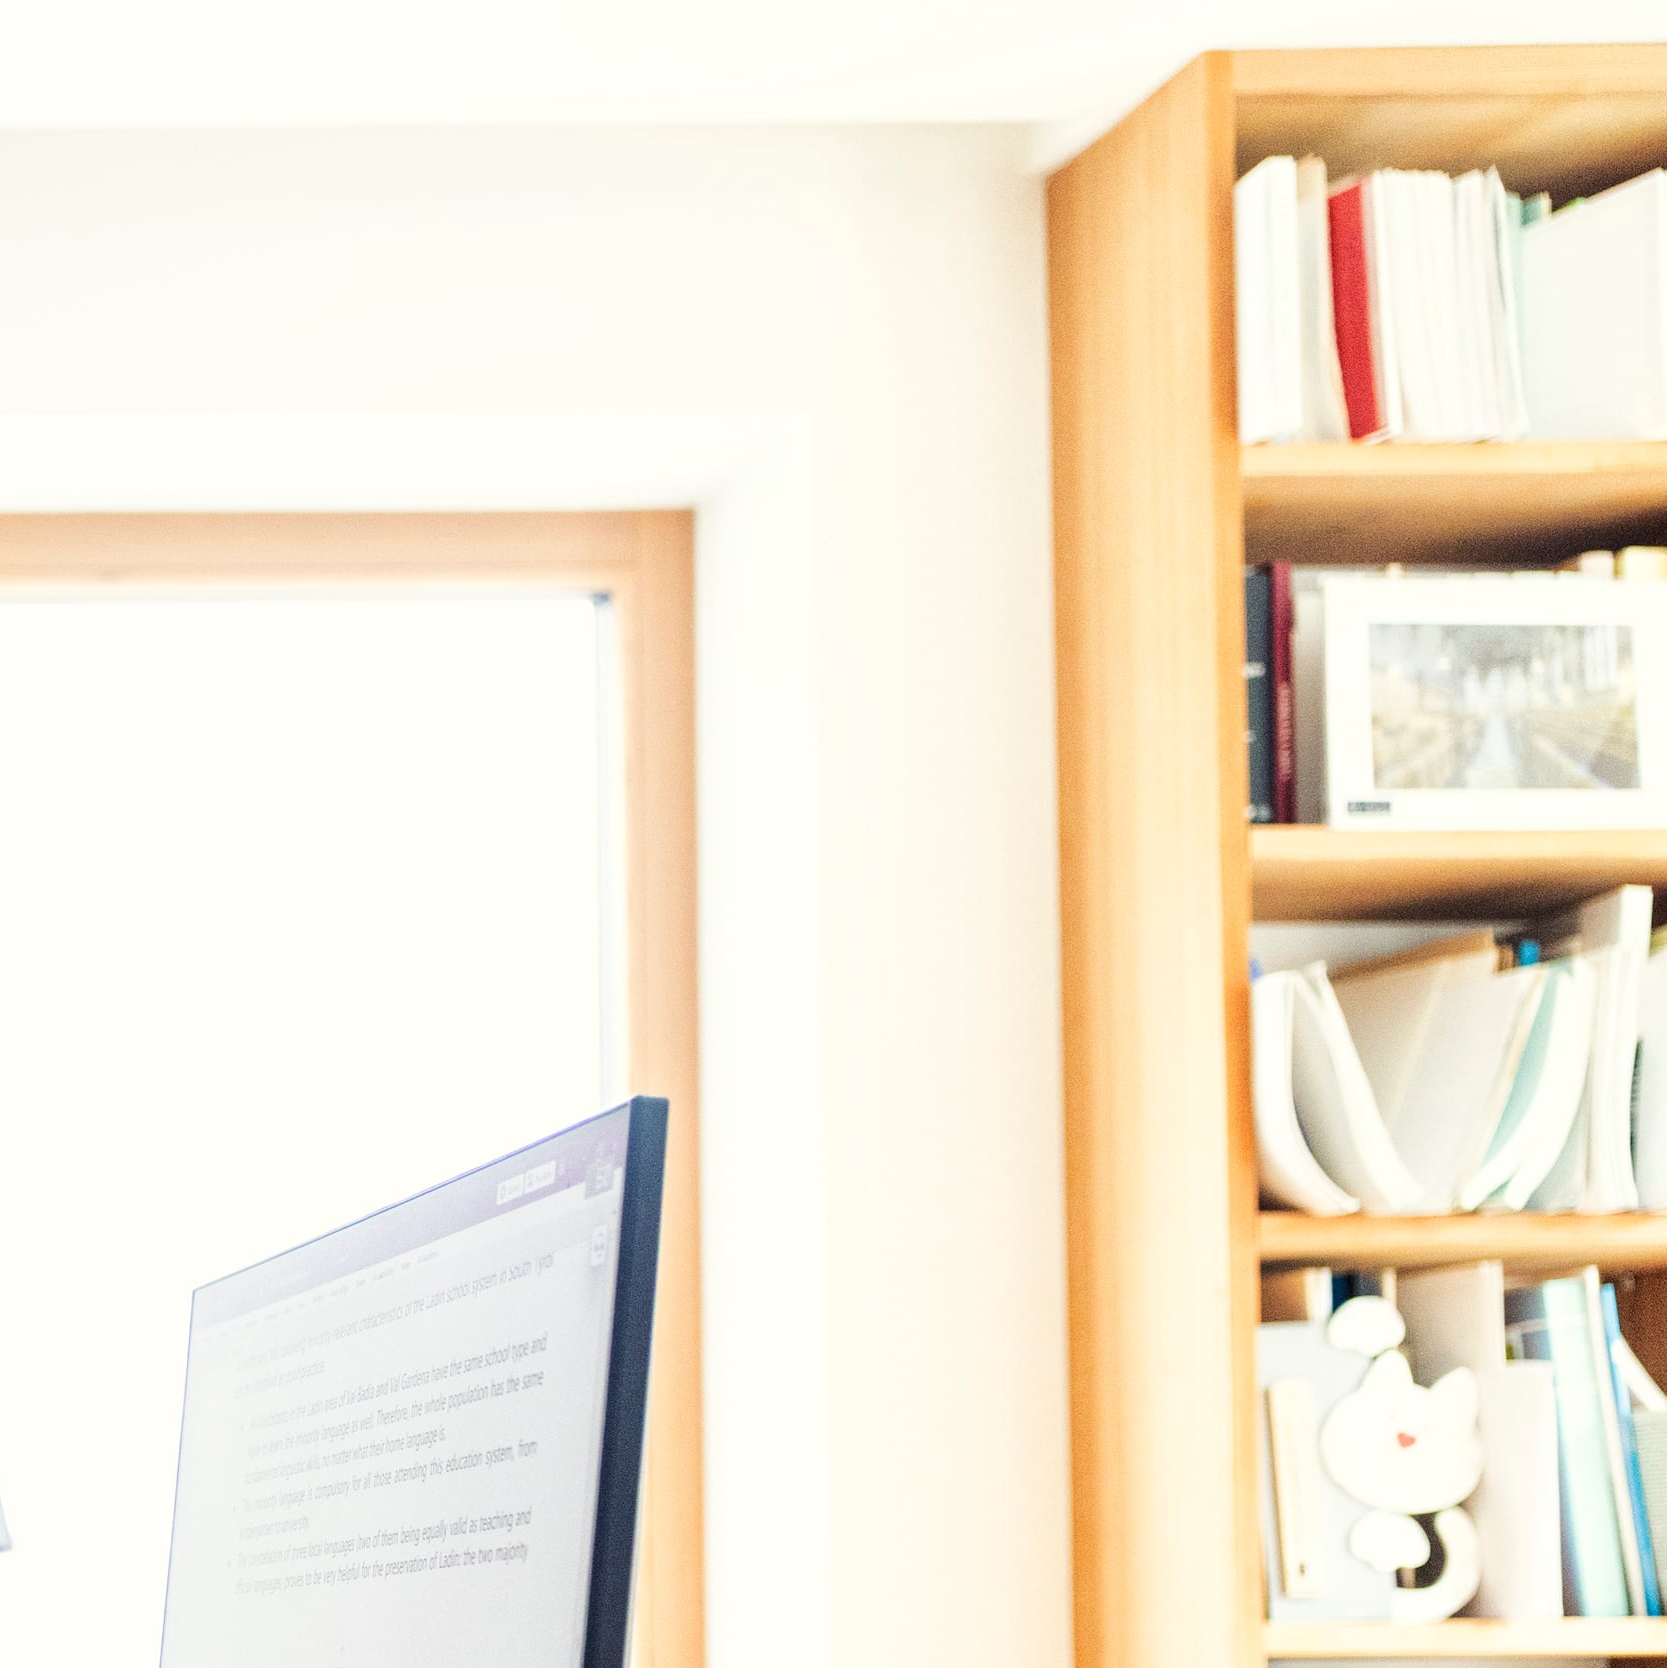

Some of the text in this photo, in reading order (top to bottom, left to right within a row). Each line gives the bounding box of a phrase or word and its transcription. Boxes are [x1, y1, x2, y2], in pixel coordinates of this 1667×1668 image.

[358, 1305, 405, 1332] characteristics
[414, 1298, 425, 1315] the
[446, 1281, 471, 1303] school
[471, 1273, 498, 1298] system
[499, 1270, 508, 1285] in
[508, 1260, 533, 1281] South
[324, 1396, 338, 1412] area
[338, 1389, 347, 1409] of
[357, 1383, 375, 1402] Badia
[376, 1379, 388, 1398] and
[389, 1373, 401, 1393] Val
[401, 1368, 430, 1391] Gardena
[431, 1360, 449, 1382] have
[449, 1355, 463, 1377] the
[463, 1354, 484, 1374] same
[483, 1342, 511, 1368] school
[512, 1341, 529, 1364] type
[530, 1331, 548, 1355] and
[296, 1429, 319, 1448] minority
[321, 1420, 350, 1443] language
[351, 1419, 359, 1434] as
[376, 1403, 408, 1427] Therefore,
[410, 1400, 423, 1419] the
[424, 1393, 447, 1414] whole
[447, 1384, 489, 1413] population
[489, 1378, 506, 1398] has
[506, 1374, 520, 1394] the
[521, 1370, 545, 1391] same
[314, 1479, 350, 1501] compulsory
[351, 1474, 362, 1492] for
[363, 1472, 373, 1490] all
[373, 1469, 393, 1488] those
[394, 1461, 427, 1483] attending
[429, 1456, 444, 1476] this
[445, 1450, 483, 1473] education
[484, 1445, 515, 1469] system,
[517, 1438, 538, 1458] from
[321, 1453, 330, 1468] no
[331, 1448, 352, 1466] matter
[352, 1441, 369, 1462] what
[369, 1437, 385, 1459] their
[386, 1436, 405, 1454] home
[406, 1428, 438, 1451] language
[438, 1424, 447, 1442] is.
[284, 1543, 292, 1562] of
[292, 1544, 307, 1560] three
[307, 1539, 323, 1559] local
[323, 1536, 355, 1560] languages
[372, 1529, 382, 1549] of
[381, 1528, 399, 1548] them
[399, 1525, 420, 1547] being
[421, 1519, 448, 1545] equally
[449, 1515, 468, 1536] valid
[468, 1518, 479, 1534] as
[479, 1509, 515, 1533] teaching
[515, 1504, 533, 1527] and
[283, 1574, 305, 1593] proves
[312, 1567, 323, 1586] be
[323, 1569, 338, 1589] very
[337, 1560, 362, 1584] helpful
[361, 1560, 373, 1580] for
[372, 1558, 385, 1578] the
[385, 1554, 428, 1581] preservation
[429, 1549, 440, 1571] of
[438, 1548, 462, 1570] Ladin:
[463, 1546, 476, 1567] the
[478, 1547, 494, 1565] two
[494, 1541, 530, 1567] majority
